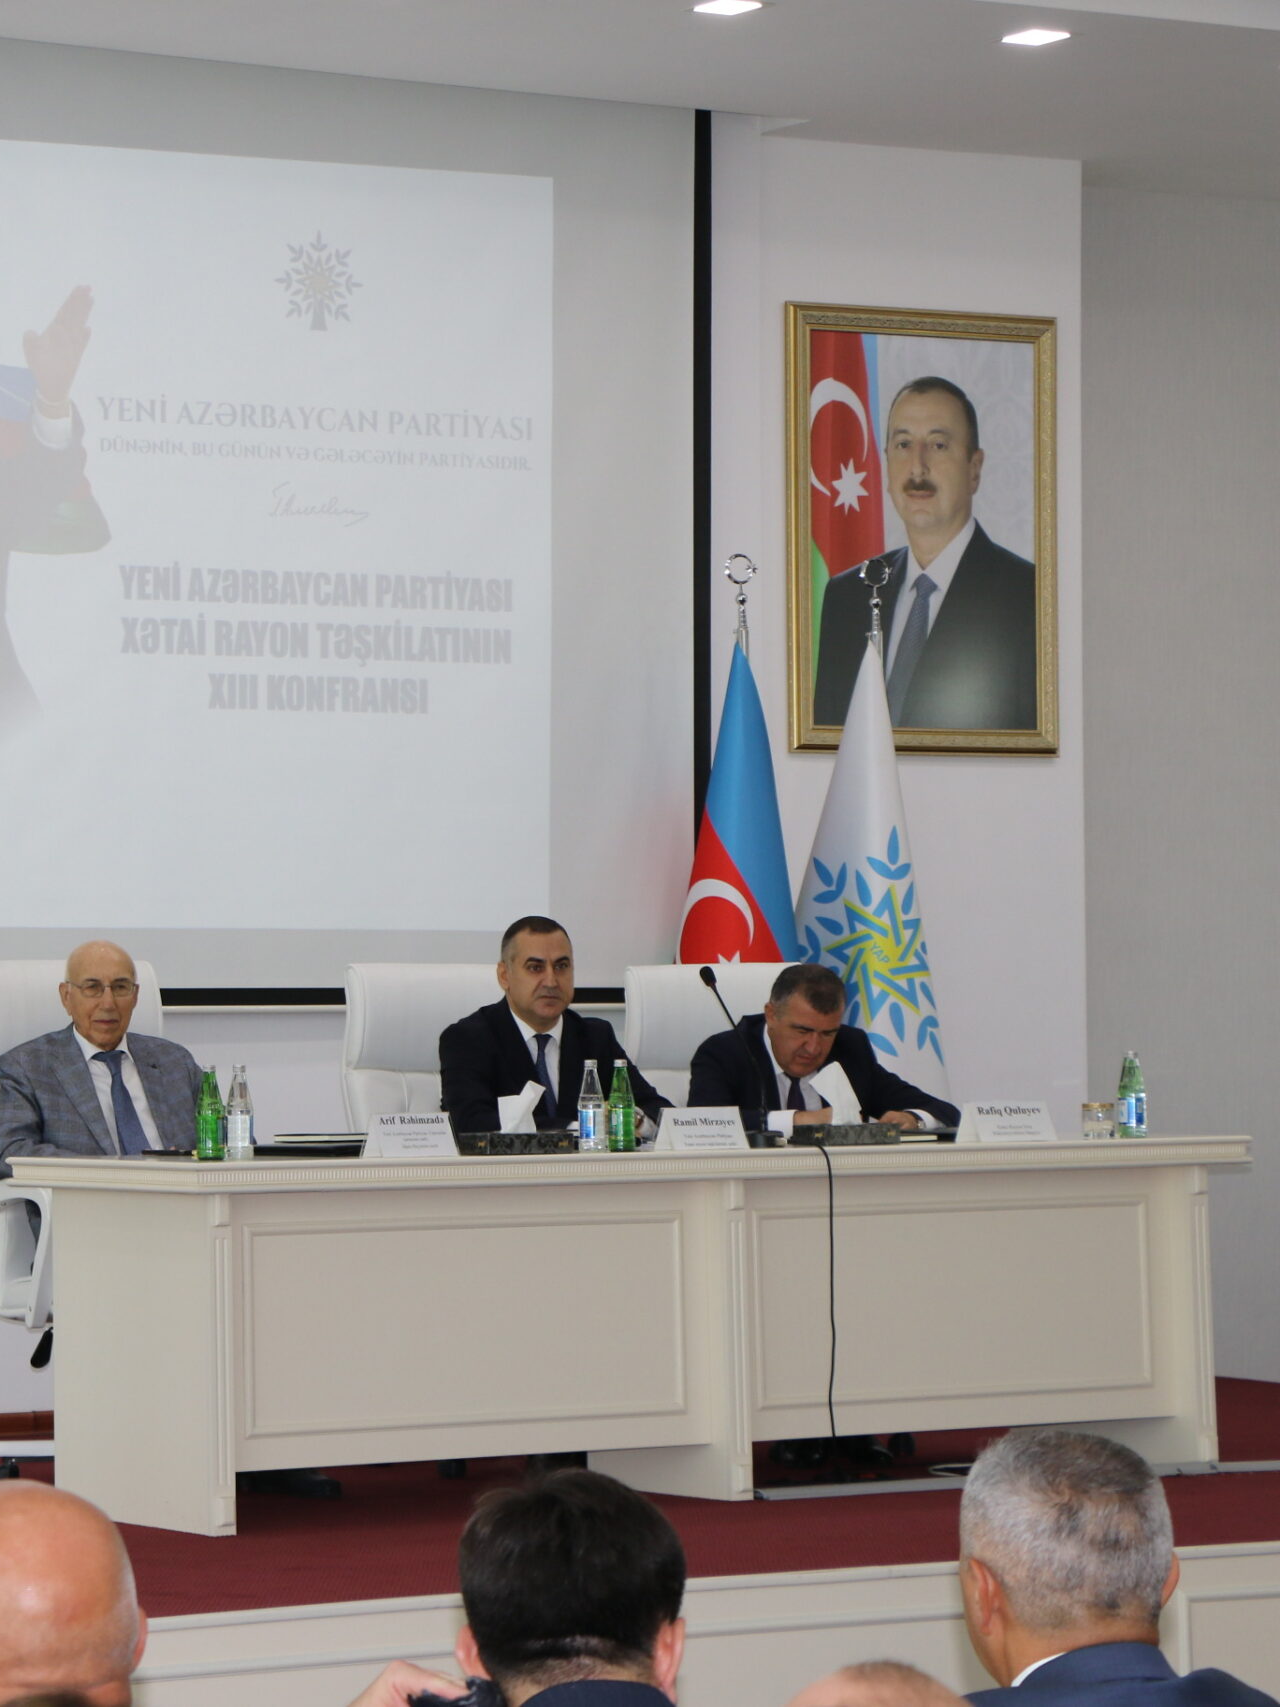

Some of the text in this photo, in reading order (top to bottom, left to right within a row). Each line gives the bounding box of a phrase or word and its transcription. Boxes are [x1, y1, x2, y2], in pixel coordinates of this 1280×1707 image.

[97, 394, 534, 441] YENİ AZƏRBAYCAN PARTİYASI
[192, 442, 214, 457] BU
[218, 439, 282, 460] GÜNÜN
[286, 445, 310, 461] VƏ
[313, 445, 415, 466] GƏLƏCƏYİN
[119, 561, 514, 613] YENİ AZƏRBAYCAN PARTİYASI
[120, 613, 513, 667] XƏTAİ RAYON TƏŞKİLATININ
[208, 672, 429, 715] XIII KONFRANSI
[379, 1116, 396, 1126] Arif
[673, 1118, 698, 1127] Ramil
[977, 1106, 1003, 1117] Rafiq
